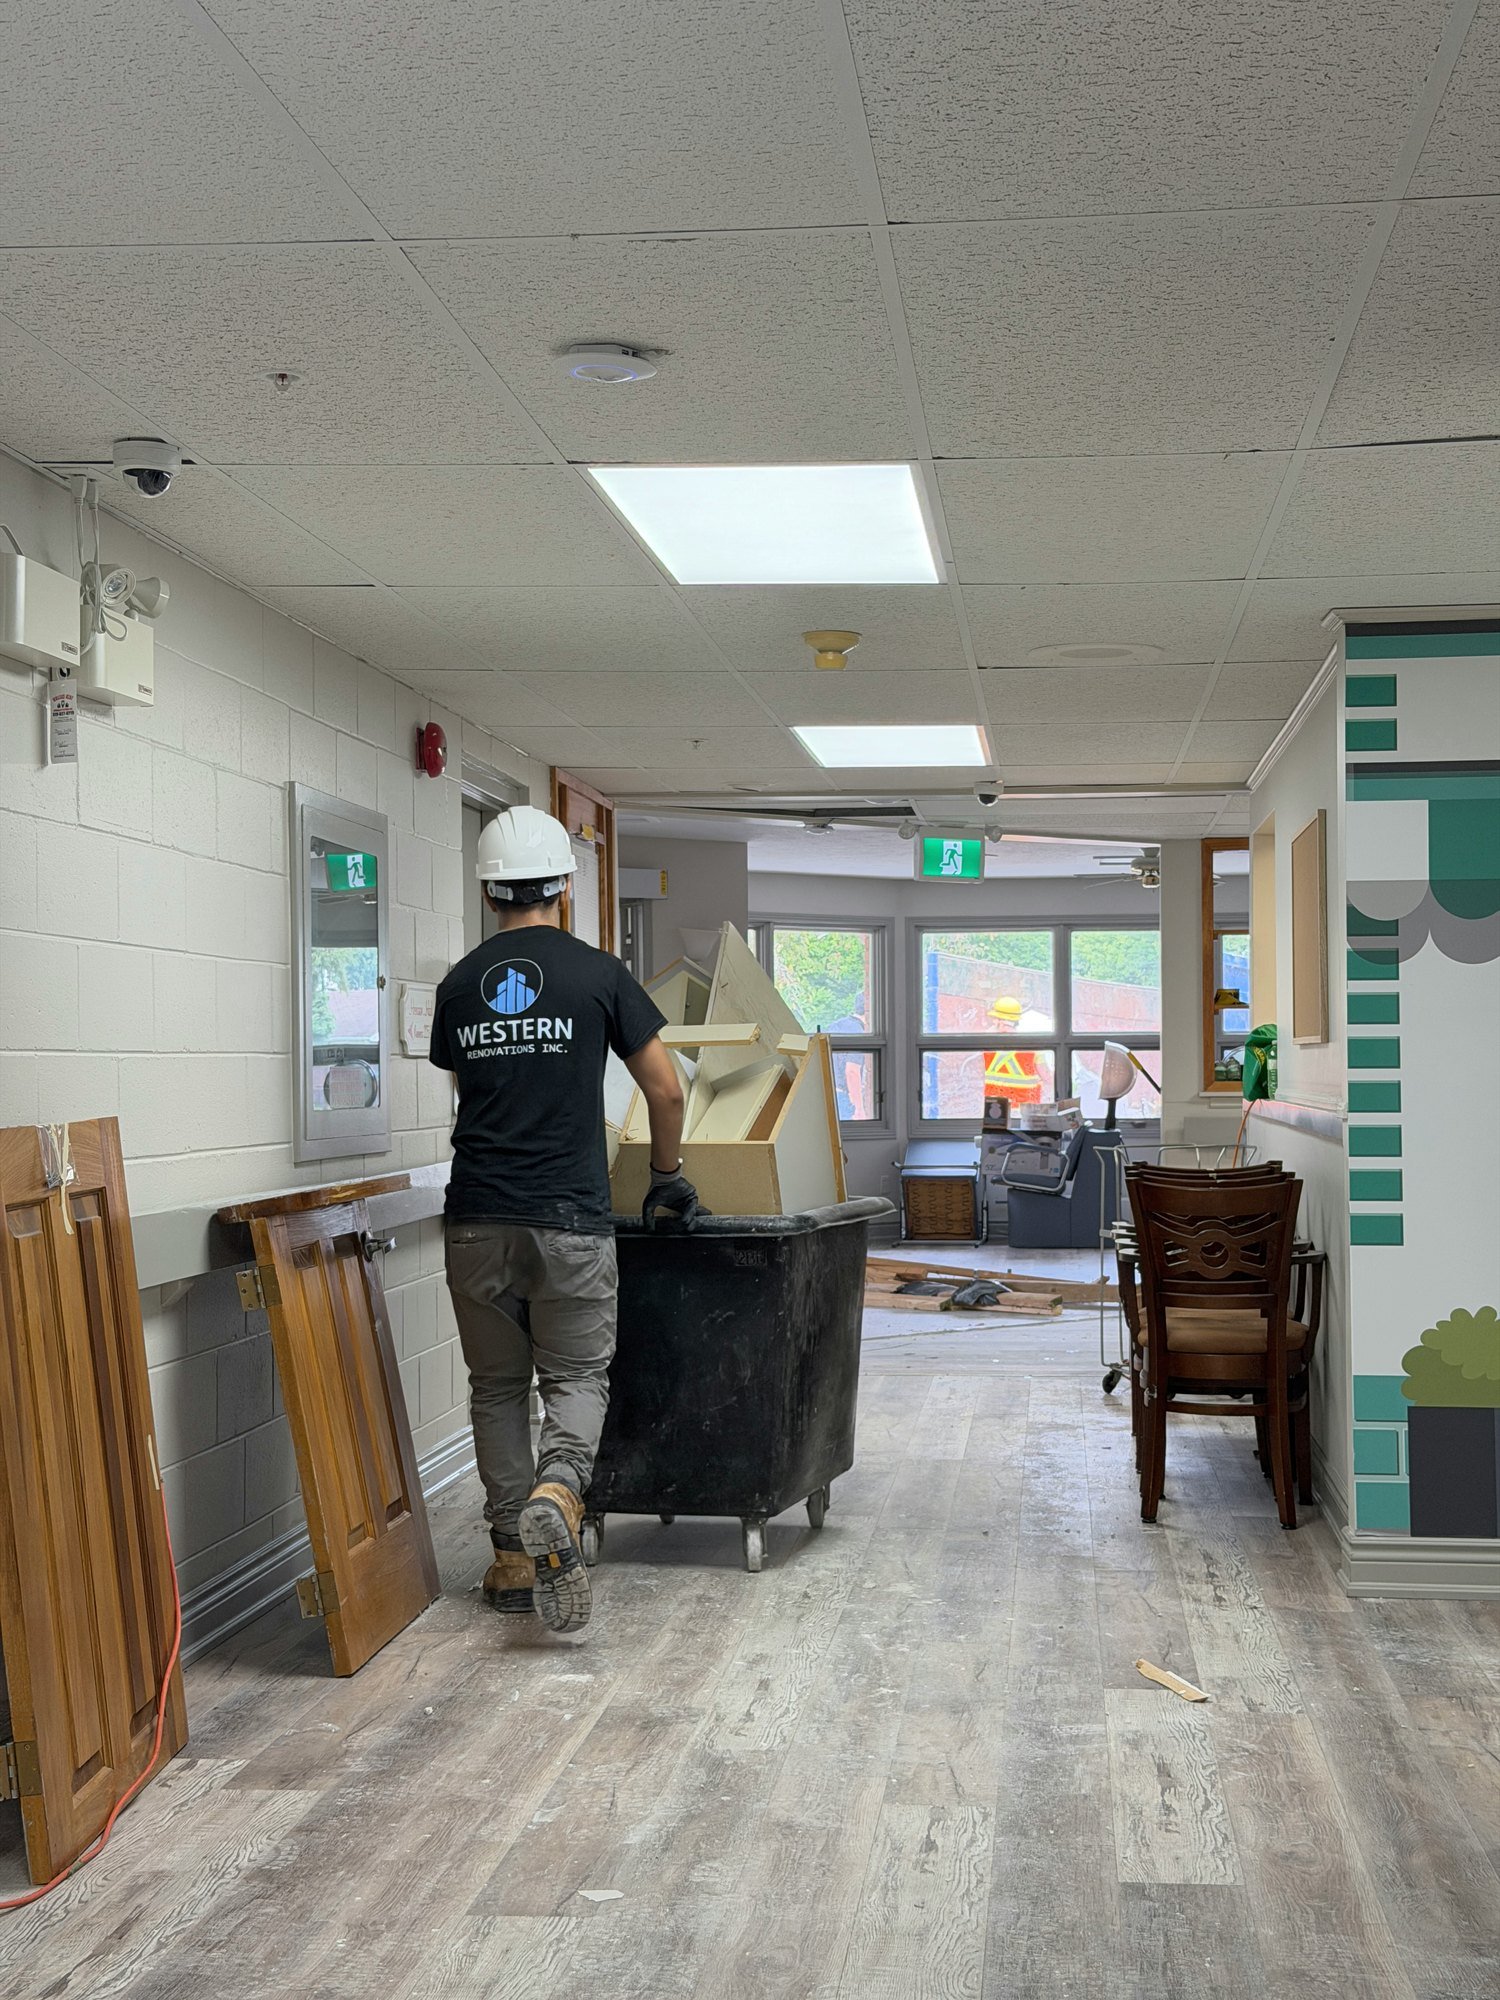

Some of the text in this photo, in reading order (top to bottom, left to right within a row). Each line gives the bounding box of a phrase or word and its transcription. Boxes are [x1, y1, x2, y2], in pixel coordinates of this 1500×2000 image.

[457, 1017, 573, 1048] WESTERN
[467, 1043, 568, 1060] RENOVATIONS INC.
